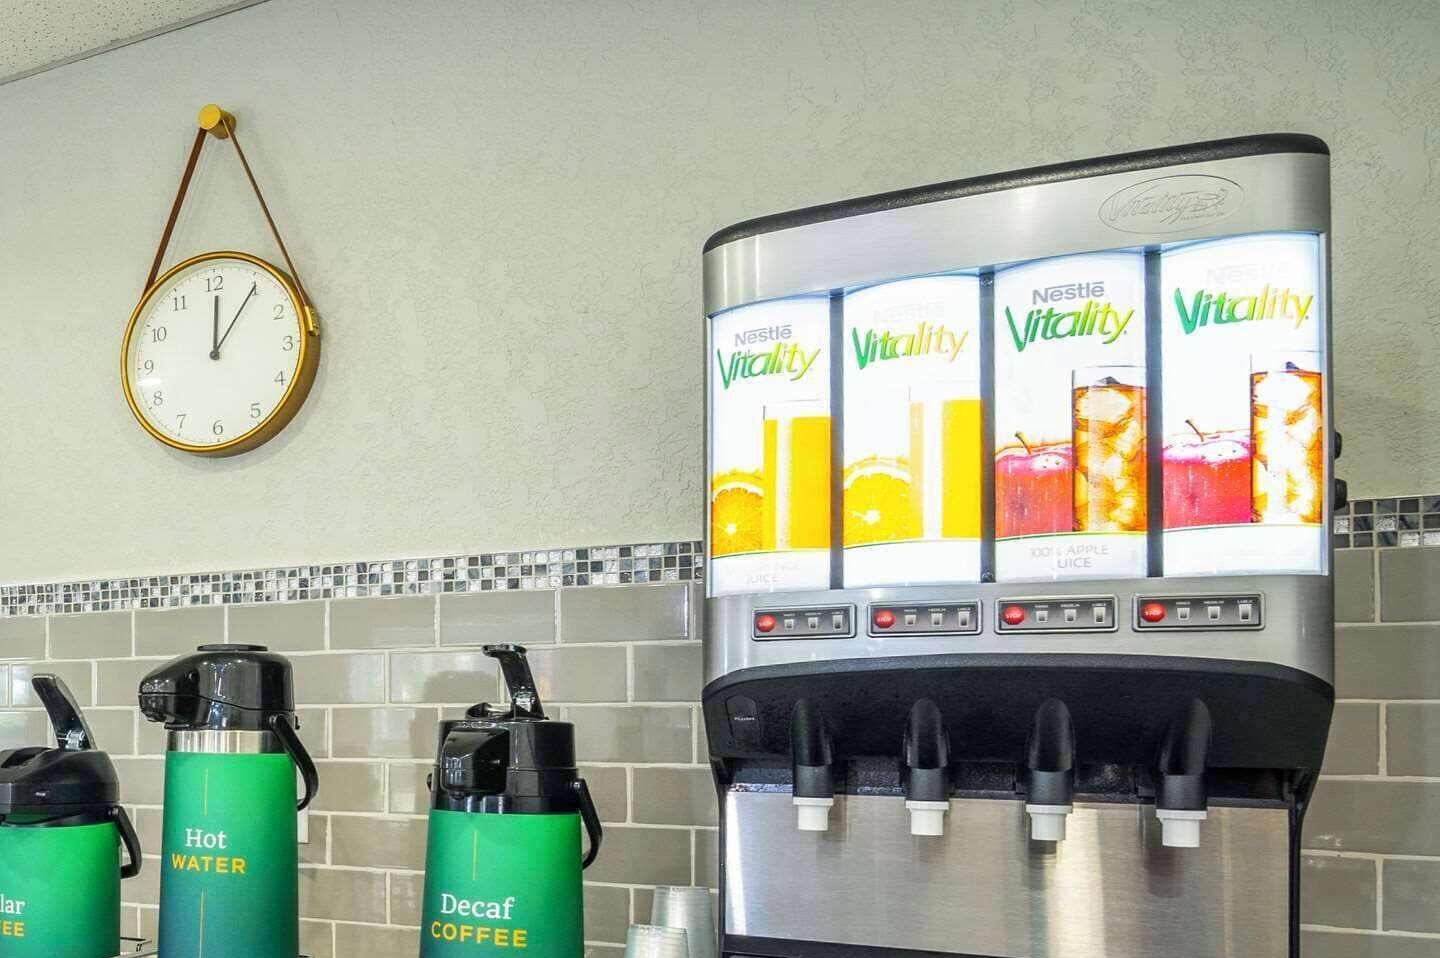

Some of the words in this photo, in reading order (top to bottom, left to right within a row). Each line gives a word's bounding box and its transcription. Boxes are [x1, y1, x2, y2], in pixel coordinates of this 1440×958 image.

[205, 275, 224, 293] 12
[172, 295, 187, 312] 11
[1174, 283, 1314, 335] Vitality
[273, 304, 284, 321] 2
[1005, 300, 1135, 352] Vitality
[151, 327, 167, 343] 10
[282, 335, 294, 351] 3
[852, 321, 969, 370] Vitality
[144, 360, 154, 375] 9
[717, 342, 822, 390] Vitality
[274, 371, 286, 386] 4
[153, 391, 163, 406] 8
[250, 403, 261, 418] 5
[176, 414, 187, 429] 7
[212, 420, 224, 436] 6
[1066, 544, 1109, 556] APPLE
[1055, 557, 1093, 569] UICE
[184, 828, 227, 849] Hot
[171, 853, 246, 874] WATER
[440, 893, 516, 920] Decaf
[431, 920, 528, 948] COFFEE
